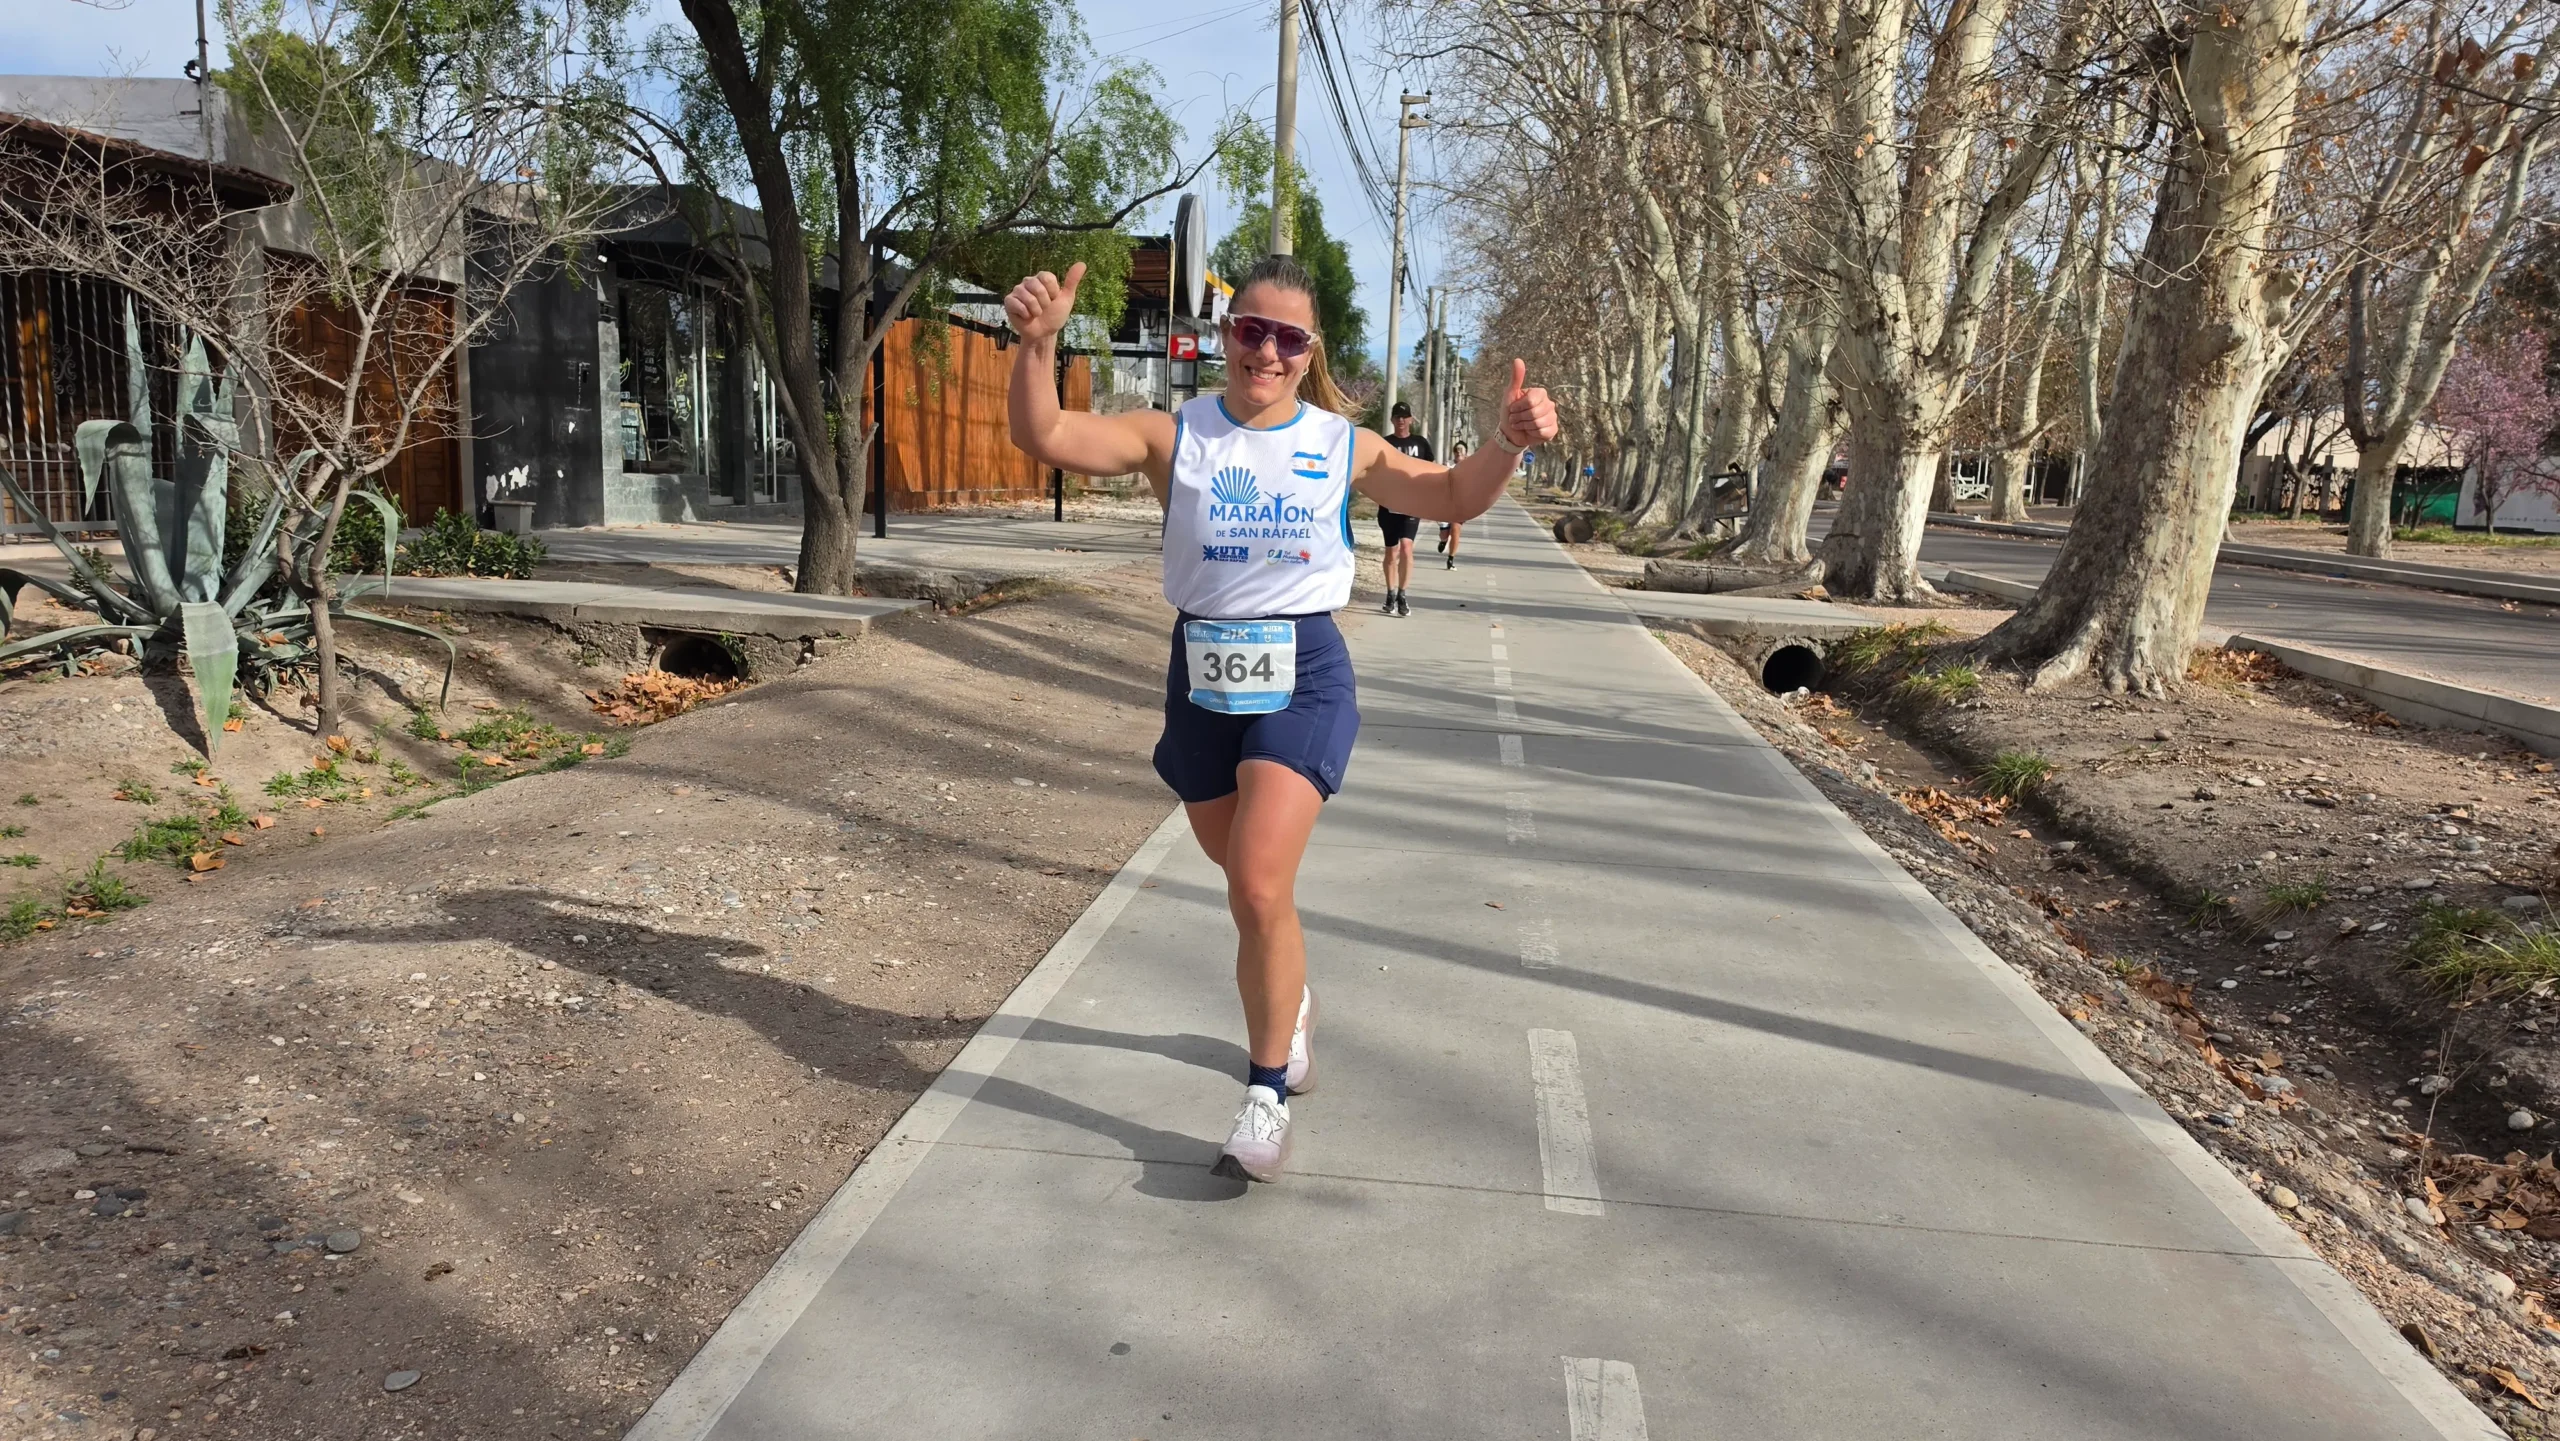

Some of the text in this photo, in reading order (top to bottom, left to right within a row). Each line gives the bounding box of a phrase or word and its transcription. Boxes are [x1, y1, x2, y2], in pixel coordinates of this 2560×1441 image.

[1176, 337, 1195, 355] P
[1209, 501, 1314, 524] MARATON
[1215, 527, 1312, 539] DE SAN RAFAEL
[1219, 546, 1249, 555] UTN
[1220, 627, 1250, 640] 21K
[1203, 652, 1274, 683] 364
